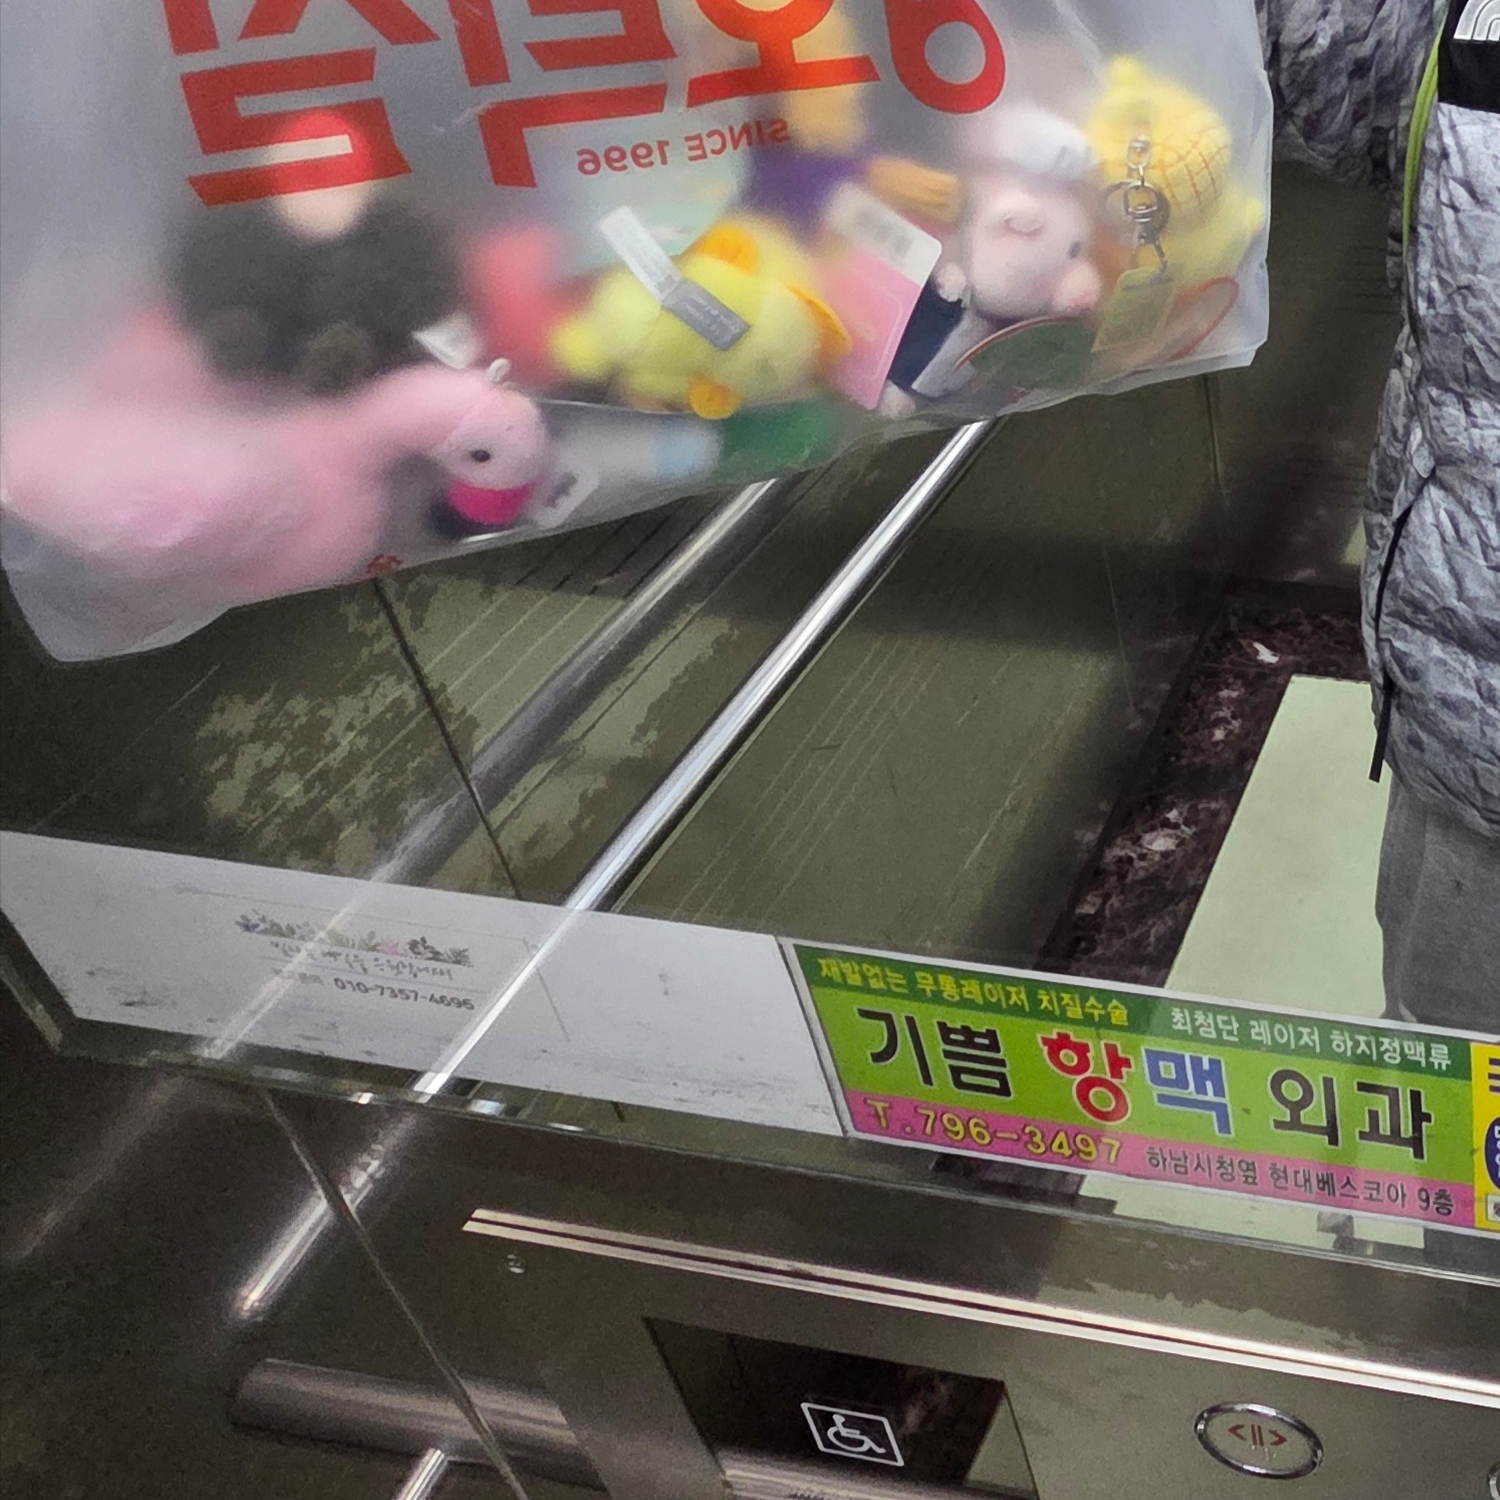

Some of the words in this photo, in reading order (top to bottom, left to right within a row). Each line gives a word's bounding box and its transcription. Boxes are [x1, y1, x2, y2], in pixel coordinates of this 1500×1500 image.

[817, 957, 909, 993] 재발없는
[914, 970, 1031, 1012] 무통레이저
[1037, 989, 1129, 1026] 치질수술
[1170, 1005, 1241, 1043] 최첨단
[1250, 1017, 1322, 1053] 레이저
[1330, 1032, 1453, 1070] 하지정맥류
[855, 1006, 1013, 1100] 기쁨
[1266, 1066, 1434, 1160] 외과
[1145, 1144, 1259, 1187] 하남시청옆
[1267, 1161, 1408, 1207] 현대베스코아
[1416, 1185, 1455, 1217] 9층
